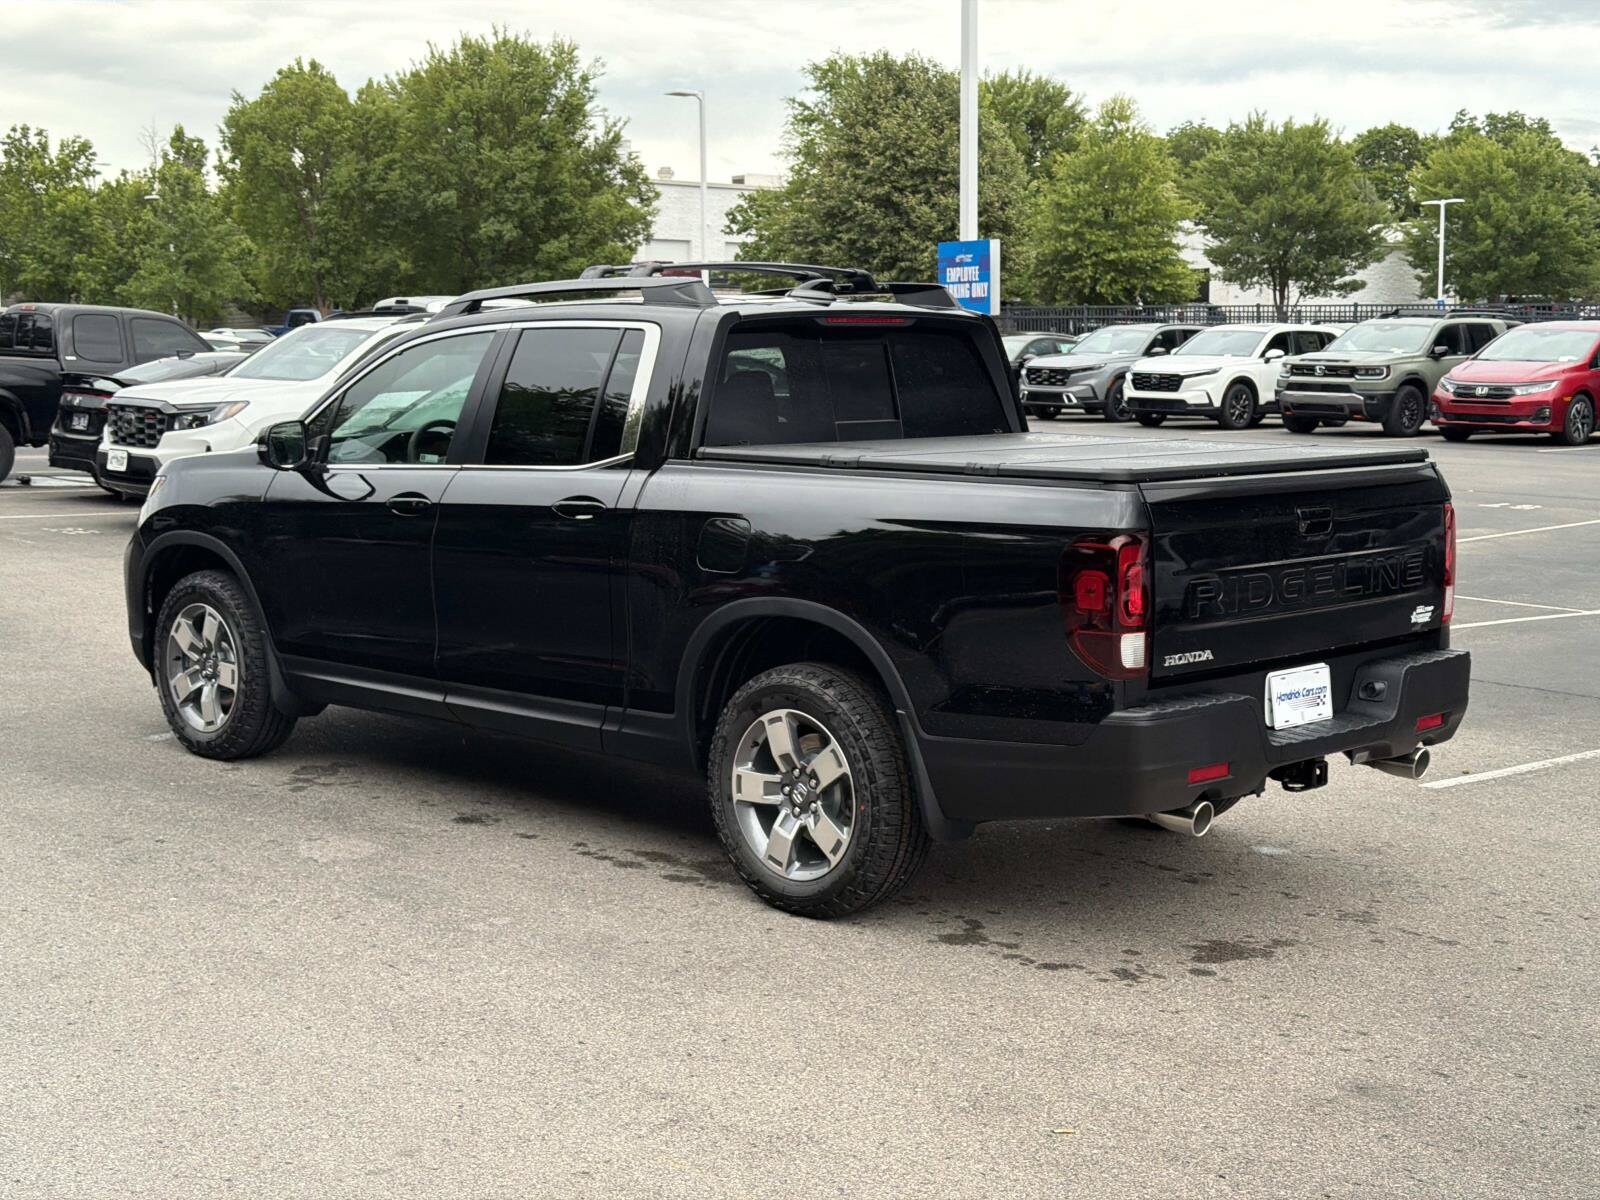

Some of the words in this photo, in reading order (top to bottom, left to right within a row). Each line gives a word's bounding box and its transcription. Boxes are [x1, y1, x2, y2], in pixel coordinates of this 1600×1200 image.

[944, 283, 970, 298] RKING
[1187, 551, 1425, 619] RIDGELINE
[1163, 649, 1214, 667] HONDA
